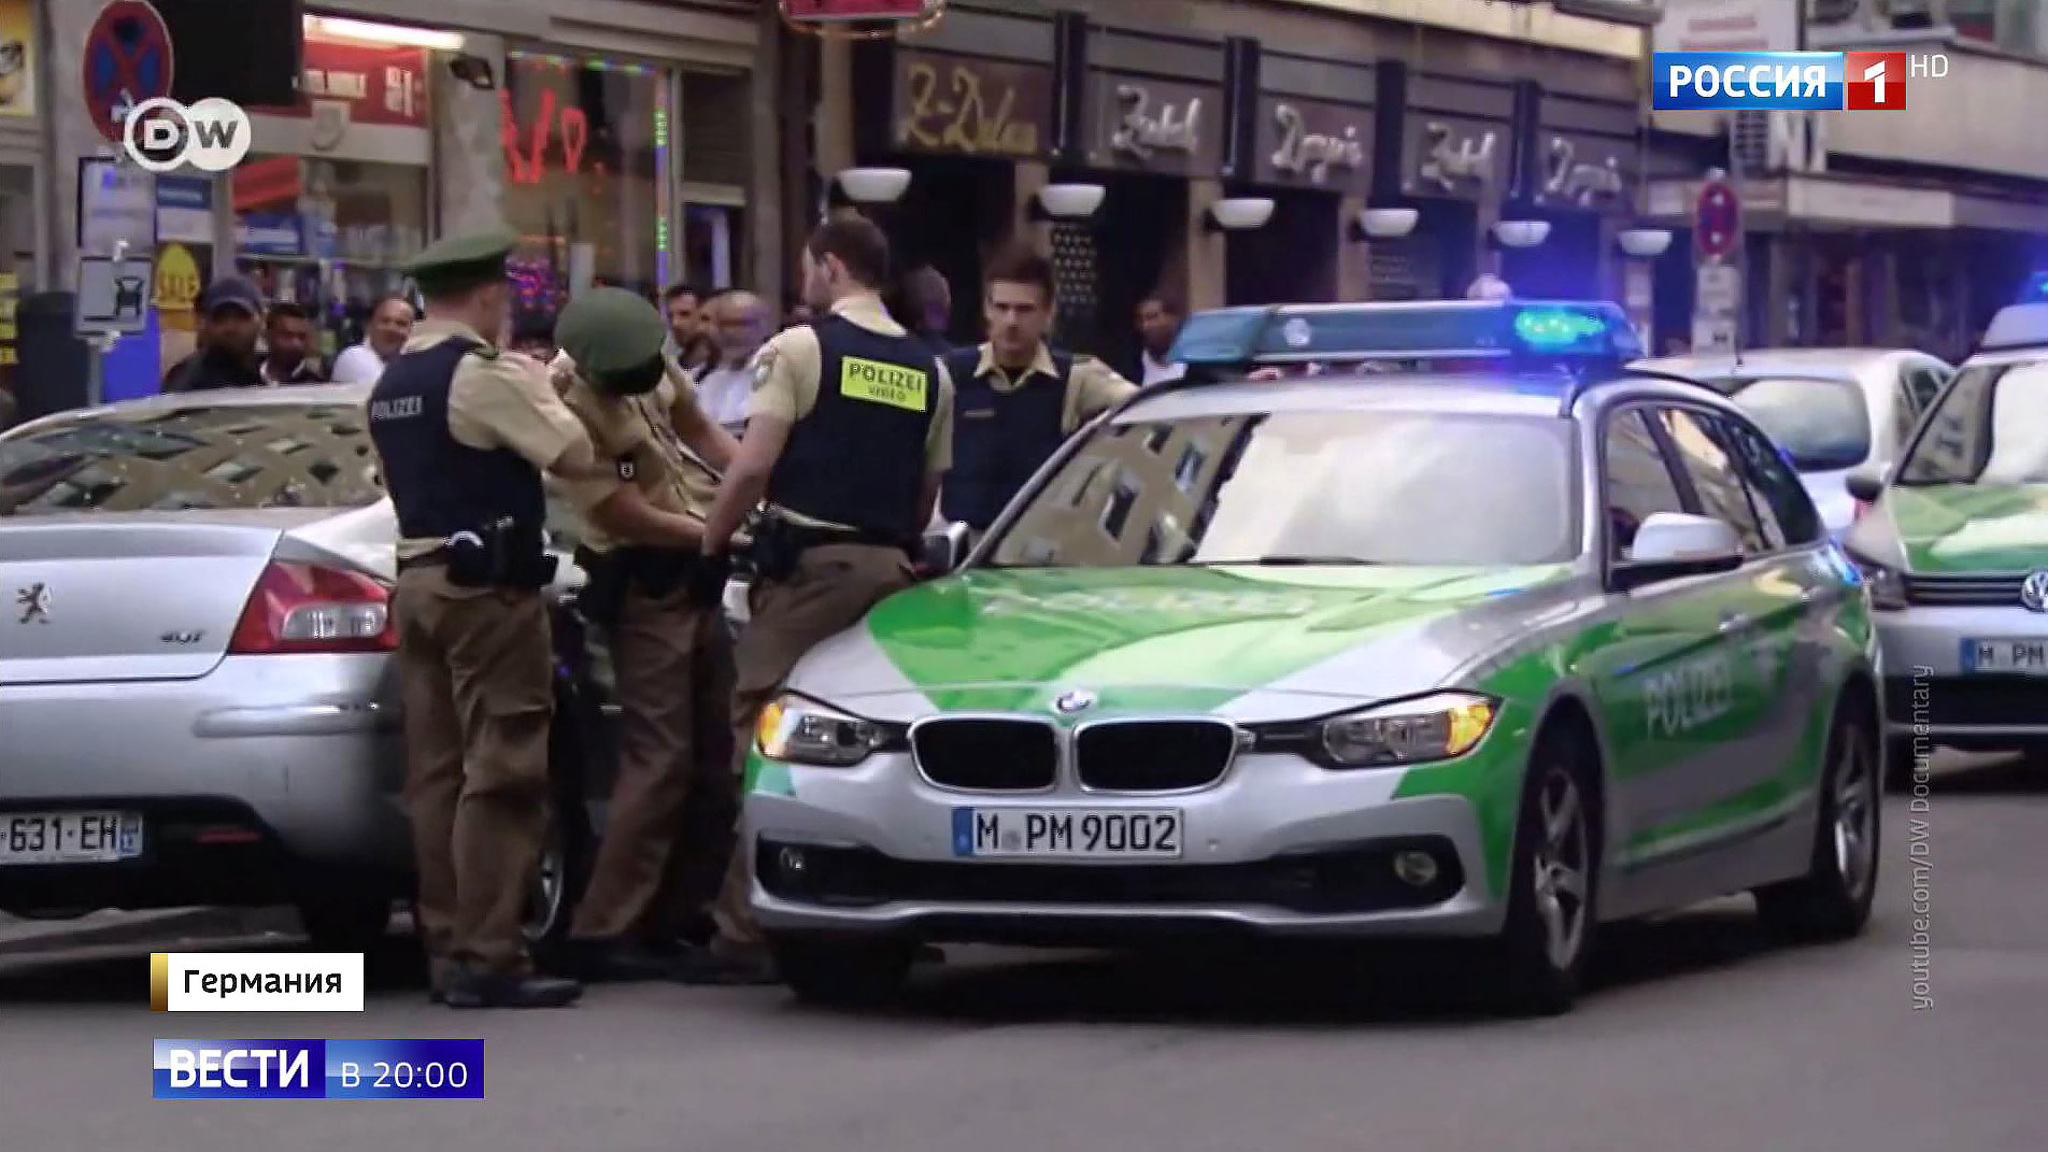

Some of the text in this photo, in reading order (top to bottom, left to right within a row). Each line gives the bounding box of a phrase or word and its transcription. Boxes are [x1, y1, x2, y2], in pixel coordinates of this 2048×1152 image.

[848, 363, 923, 393] POLIZEI
[868, 385, 907, 402] VIDEO
[1644, 655, 1735, 736] POLIZEI
[976, 812, 998, 850] M
